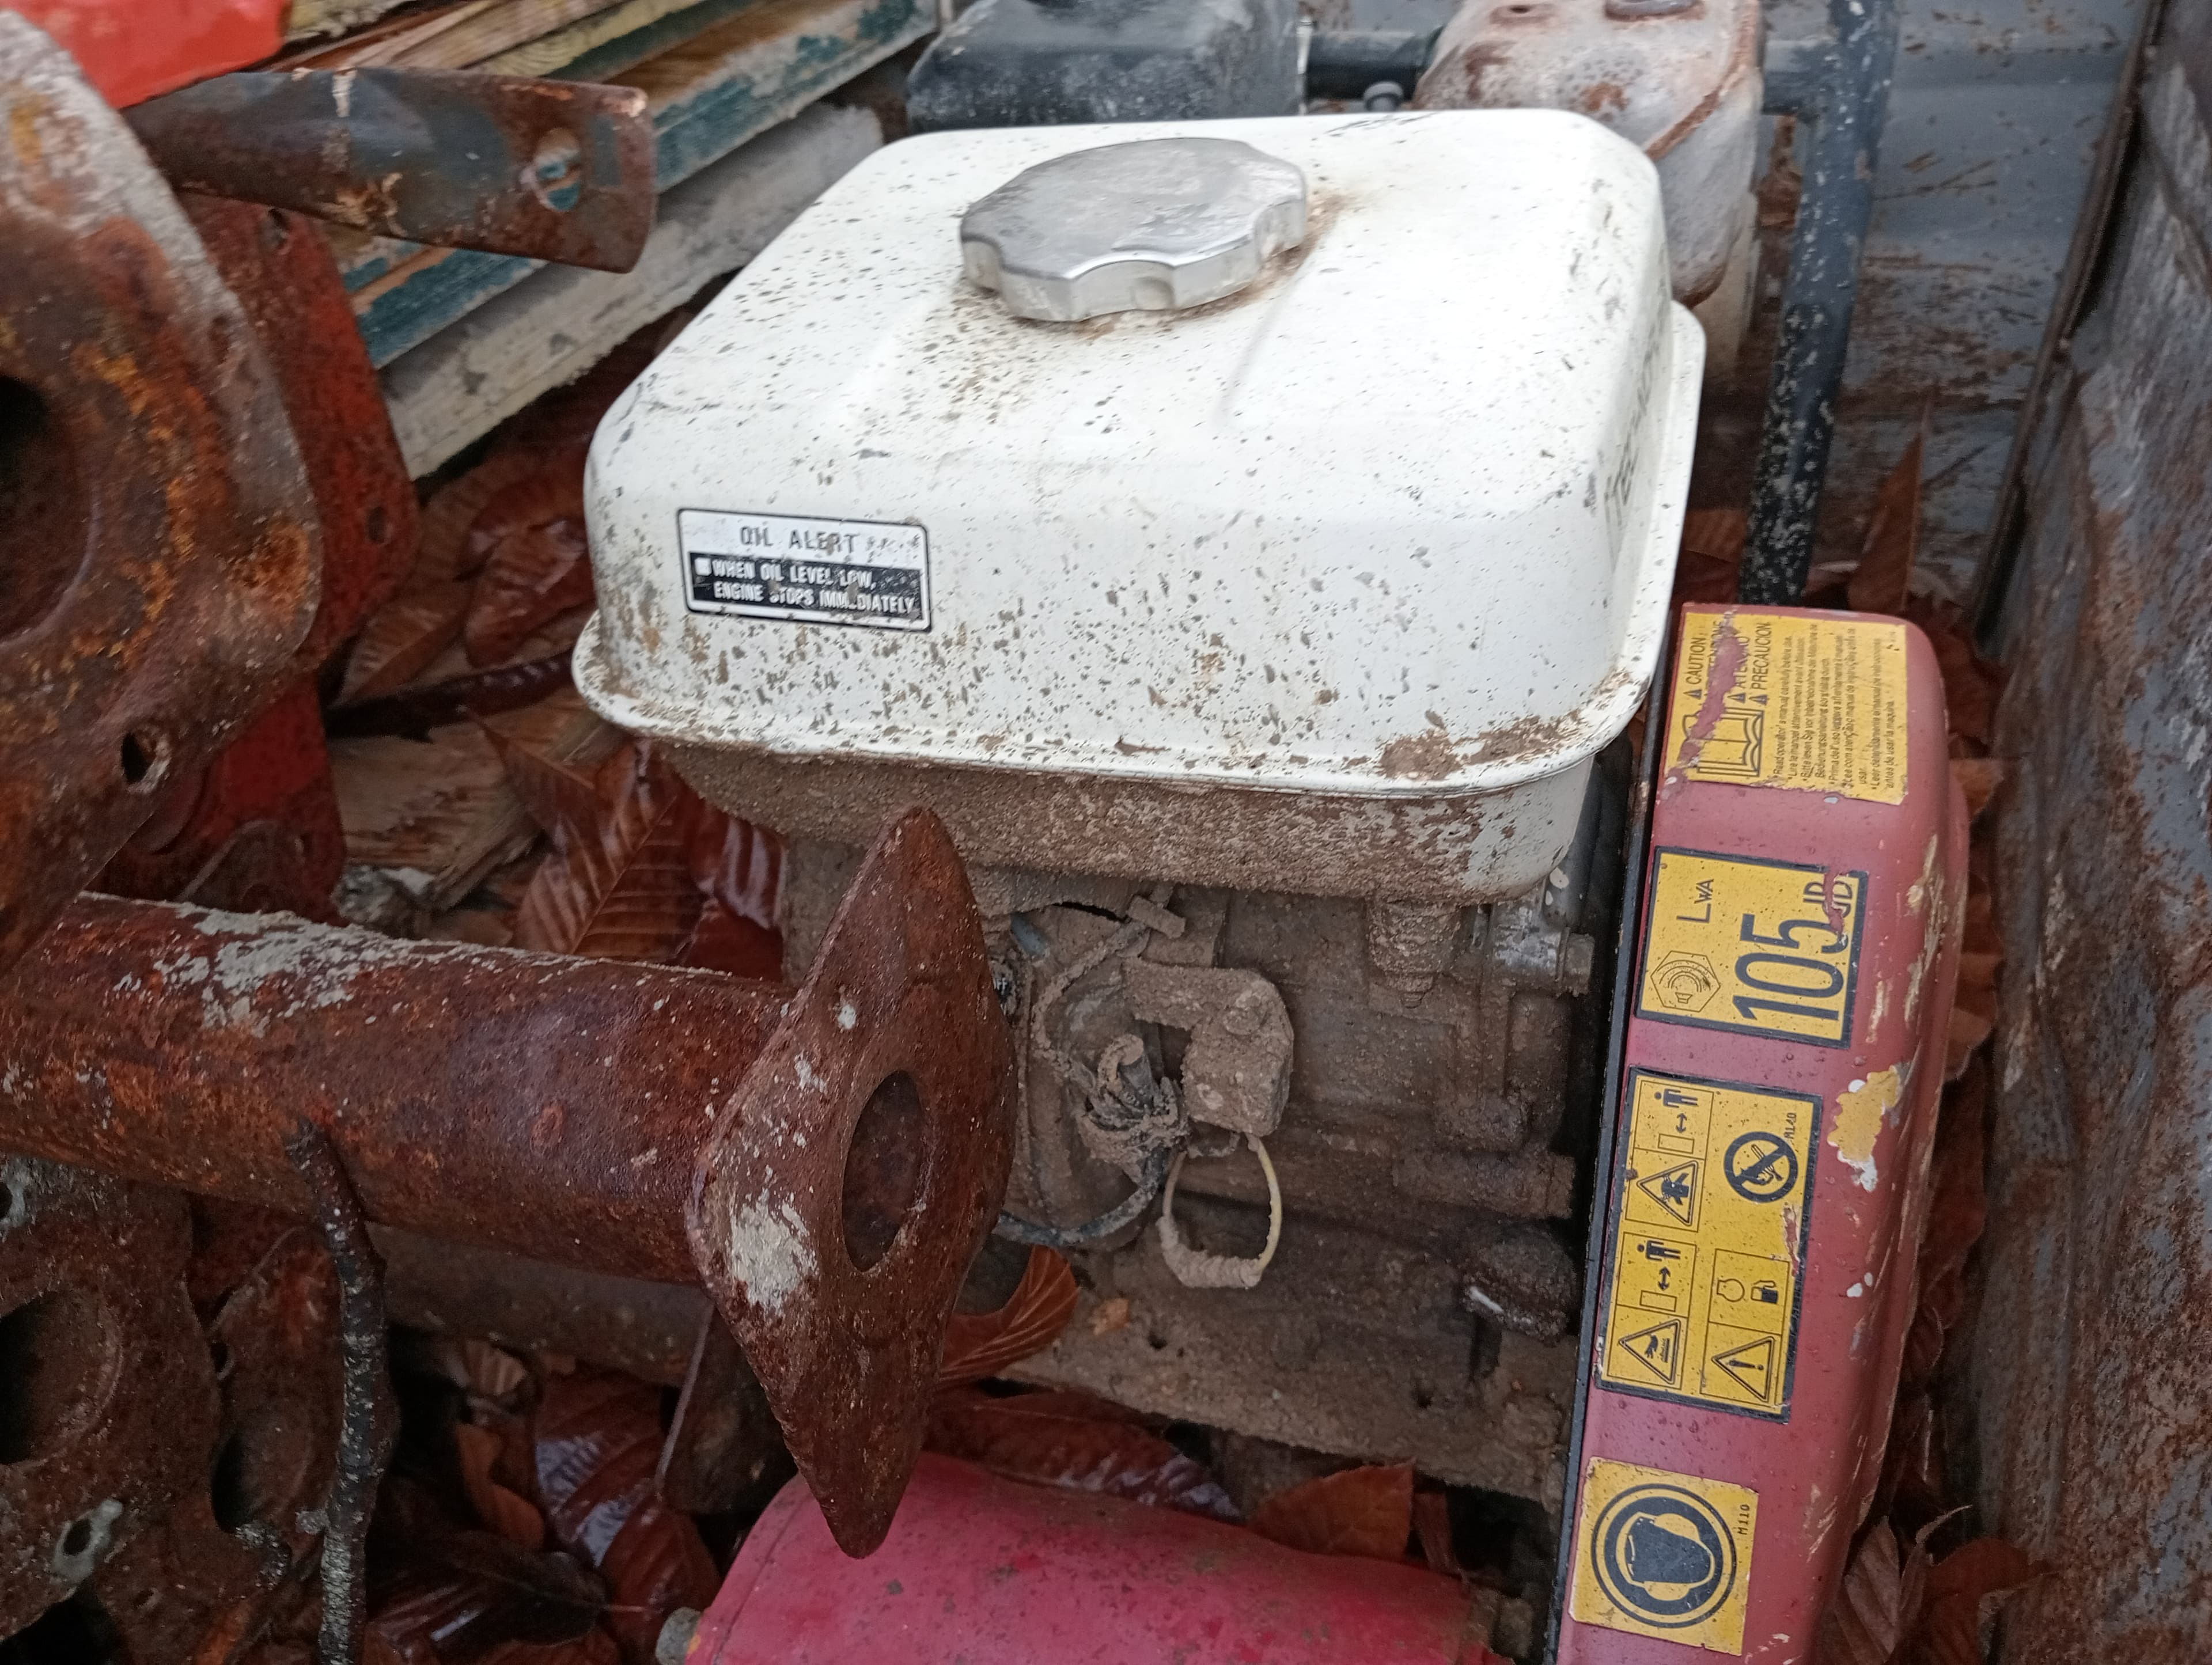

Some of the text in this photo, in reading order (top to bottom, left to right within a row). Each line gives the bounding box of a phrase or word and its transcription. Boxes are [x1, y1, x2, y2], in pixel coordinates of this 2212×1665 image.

[740, 526, 861, 555] OIL ALERT
[712, 559, 756, 579] WHEN
[760, 563, 785, 582] OIL
[790, 564, 834, 586] LEVEL
[713, 581, 764, 602] ENGINE
[1684, 638, 1706, 685] CAUTION
[1732, 913, 1849, 1022] 105
[1737, 1504, 1750, 1535] M110
